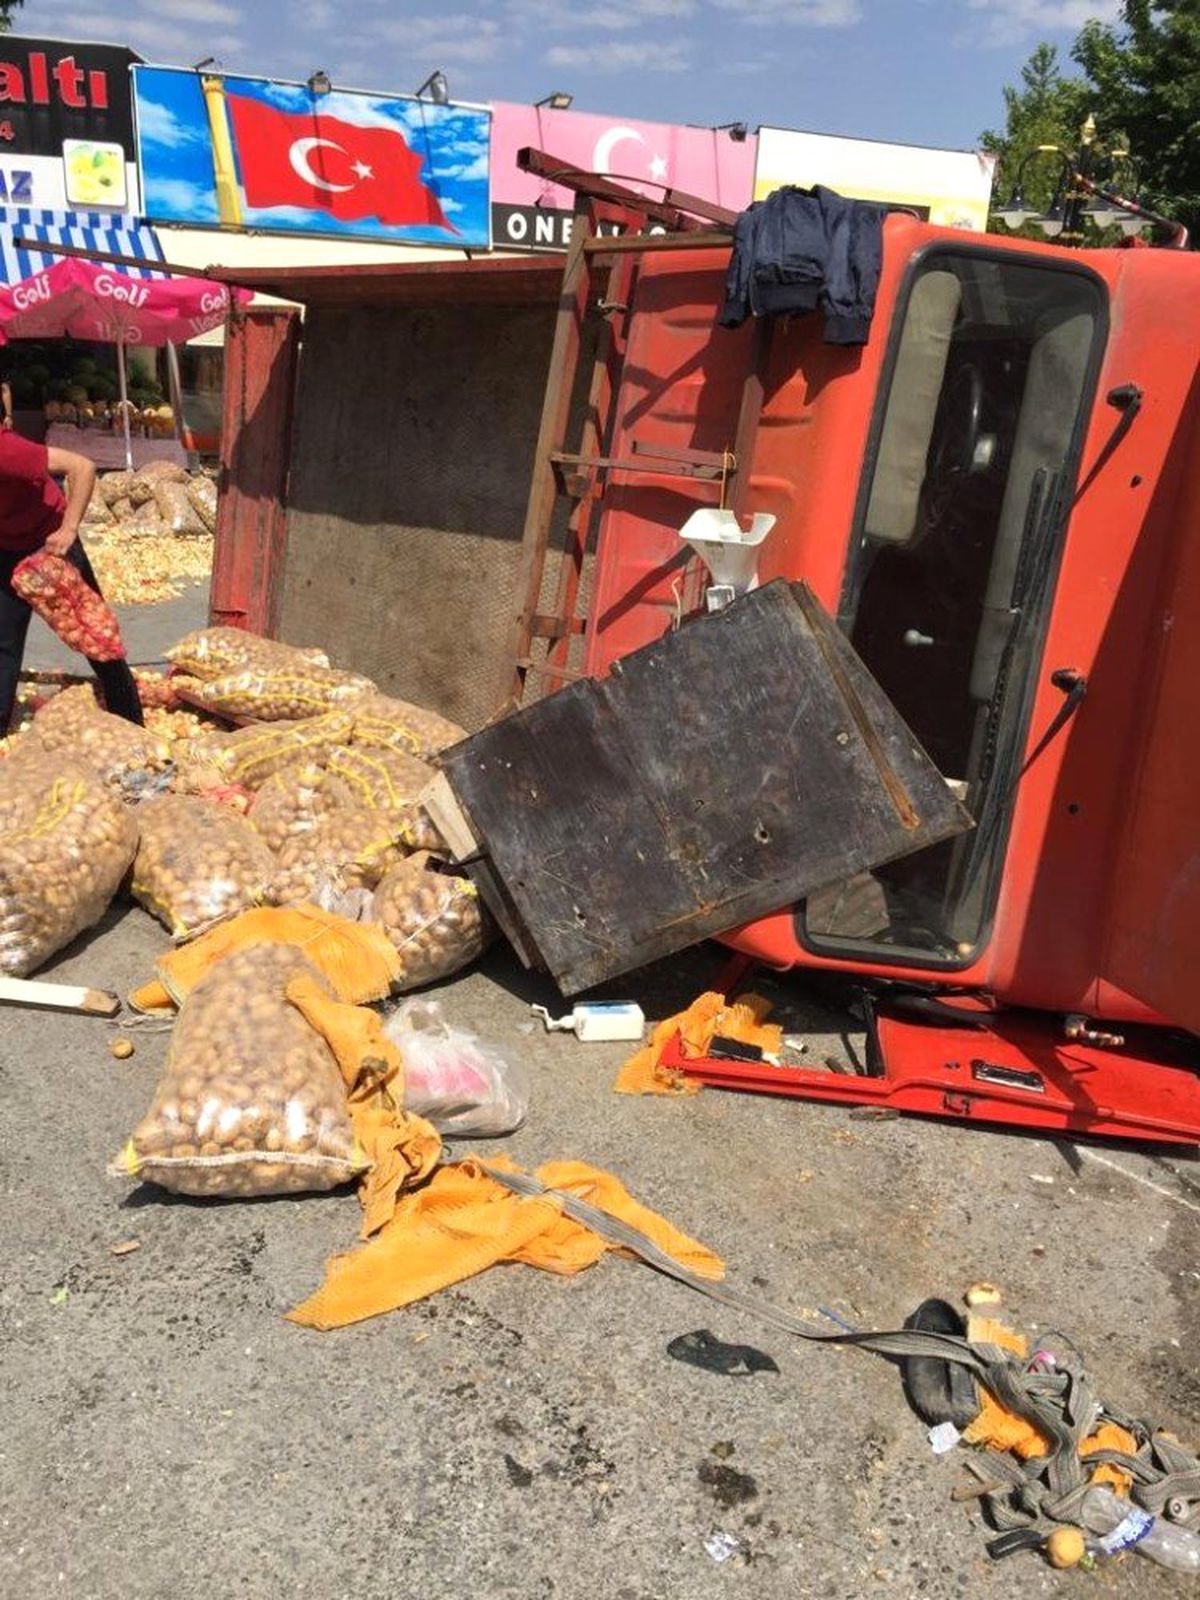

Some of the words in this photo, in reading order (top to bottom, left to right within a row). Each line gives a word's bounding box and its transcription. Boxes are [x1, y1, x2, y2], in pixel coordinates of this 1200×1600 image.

[13, 275, 51, 309] Golf
[94, 275, 150, 307] Golf
[201, 288, 230, 313] Gol
